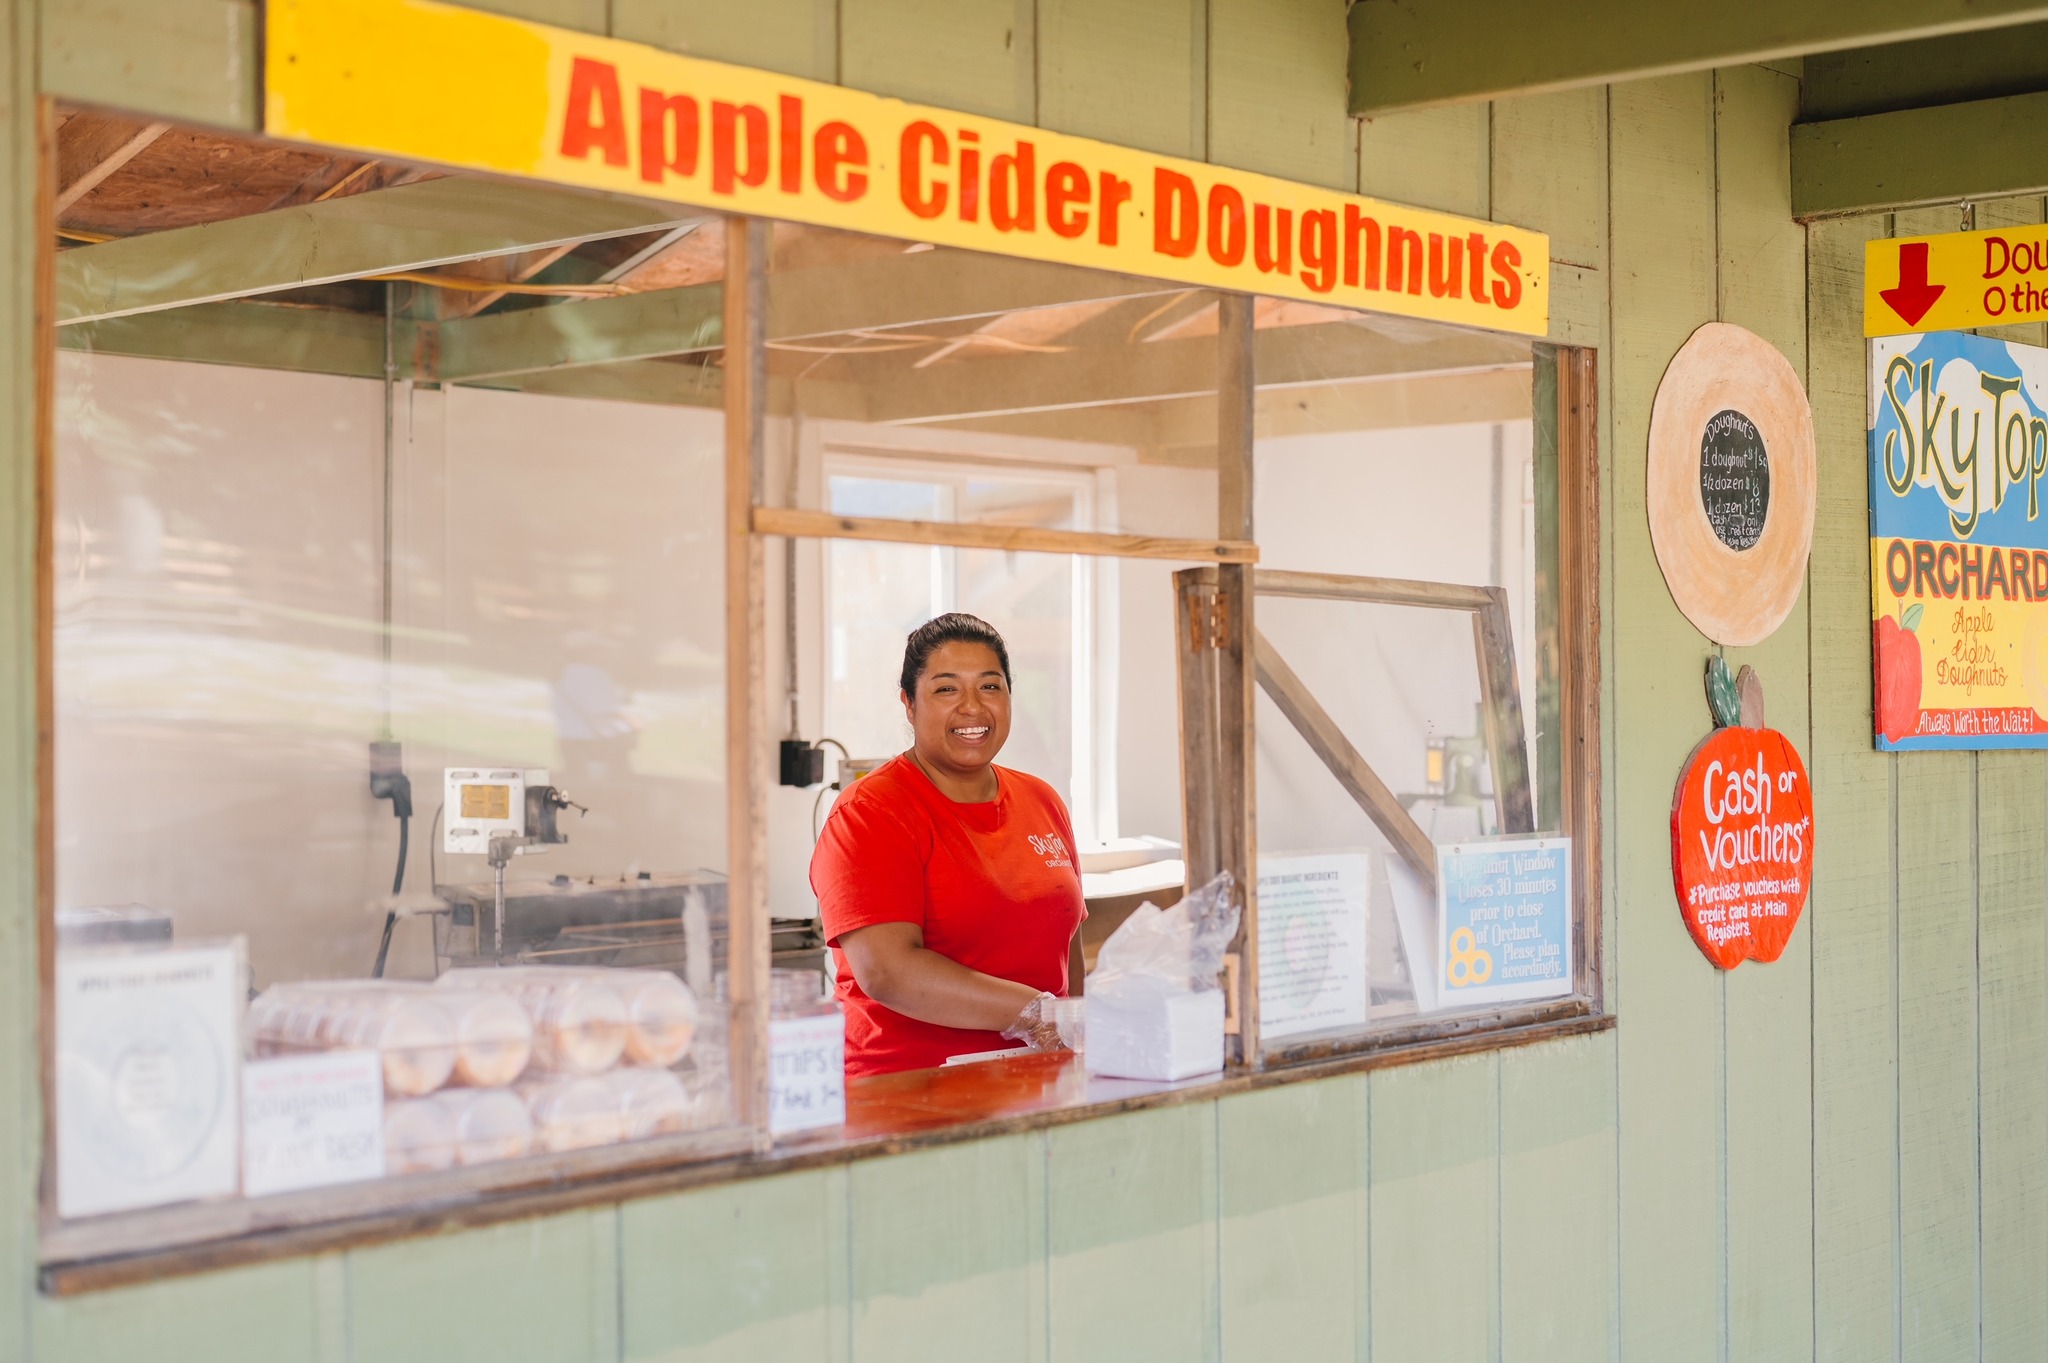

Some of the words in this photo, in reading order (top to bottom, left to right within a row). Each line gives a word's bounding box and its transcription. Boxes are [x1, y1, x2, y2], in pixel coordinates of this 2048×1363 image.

[560, 55, 870, 204] Apple
[898, 119, 1132, 247] Cider
[1982, 236, 2048, 280] Dou
[1706, 412, 1754, 442] Doughnuts
[1703, 445, 1710, 467] 1
[1711, 446, 1748, 474] doughnut
[1715, 474, 1744, 490] dozen
[1886, 539, 2048, 602] ORCHARD
[1951, 605, 1995, 641] Apple
[1951, 634, 1995, 664] Cider
[1937, 657, 2009, 697] Doughnuts
[1915, 710, 1951, 735] Always
[1953, 710, 1980, 735] Worth
[1982, 710, 2000, 734] the
[2002, 709, 2034, 734] Wait!
[1703, 751, 1772, 825] Cash
[1778, 770, 1798, 793] or
[1512, 850, 1557, 876] Window
[1459, 878, 1494, 904] Closes
[1497, 877, 1512, 897] 30
[1515, 876, 1557, 896] minutes
[1743, 875, 1780, 896] vouchers
[1780, 877, 1800, 894] with
[1470, 902, 1500, 927] prior
[1504, 902, 1515, 921] to
[1517, 898, 1544, 918] close
[1698, 904, 1726, 924] credit
[1729, 901, 1748, 919] card
[1751, 900, 1763, 918] at
[1765, 900, 1788, 917] Main
[1477, 924, 1489, 944] of
[1492, 920, 1542, 947] Orchard.
[1706, 921, 1751, 947] Registers.
[1503, 942, 1536, 965] Please
[1538, 939, 1560, 962] plan
[1501, 955, 1562, 979] accordingly.
